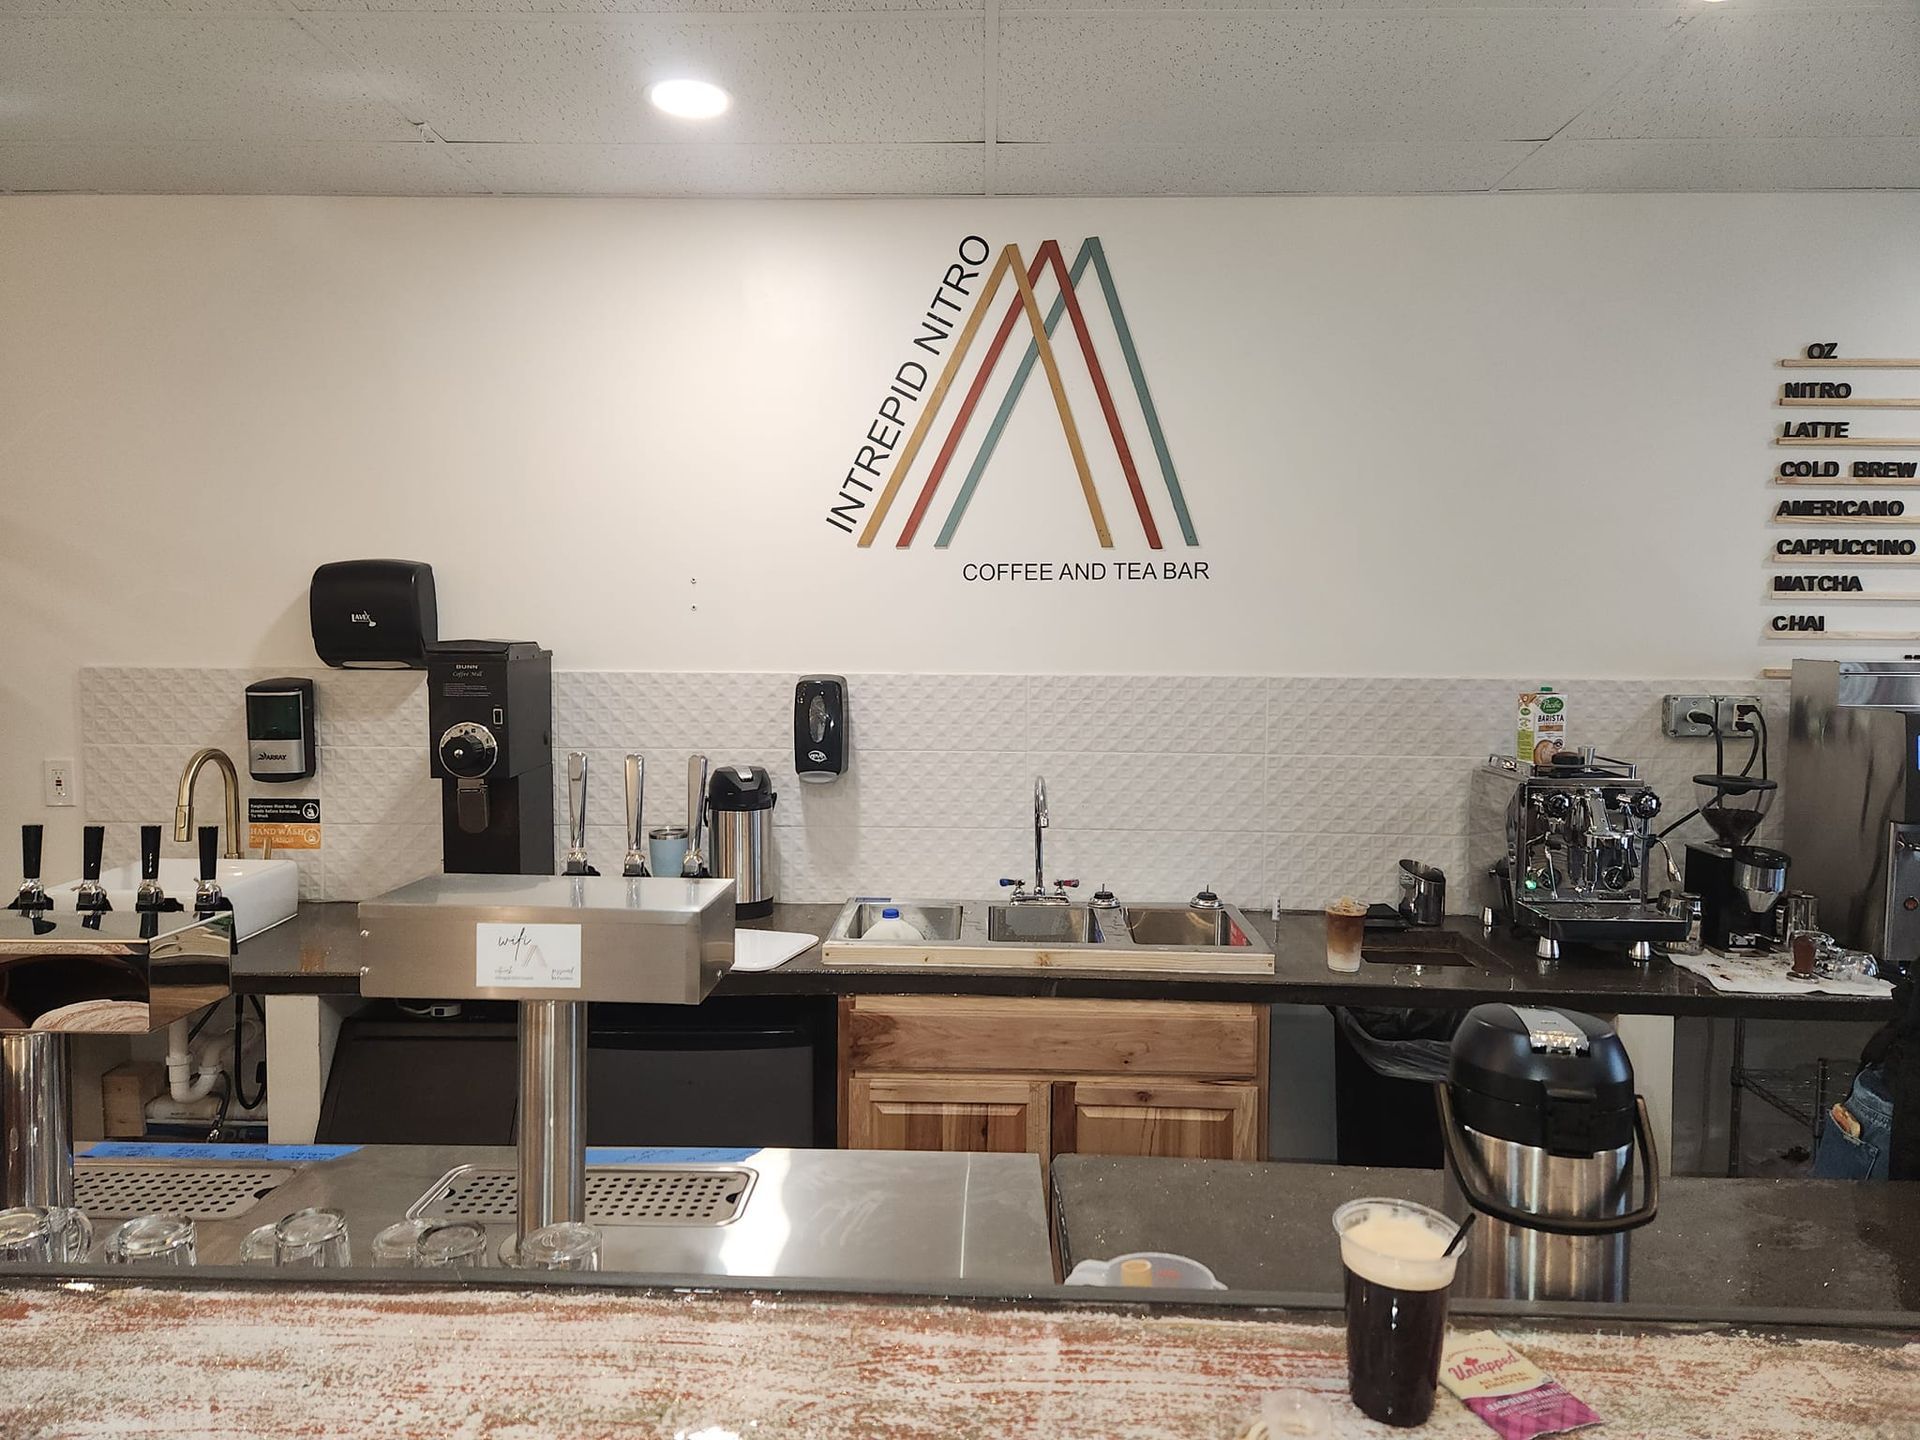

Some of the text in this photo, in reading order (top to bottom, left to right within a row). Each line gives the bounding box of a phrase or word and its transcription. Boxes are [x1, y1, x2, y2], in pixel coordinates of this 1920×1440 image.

[1807, 342, 1838, 359] OZ
[825, 234, 990, 534] INTREPID NITRO
[1784, 382, 1852, 399] NITRO
[1783, 421, 1849, 438] LATTE
[1780, 461, 1918, 478] COLD BREW
[1776, 500, 1905, 517] AMERICANO
[1776, 538, 1916, 556] CAPPUCCINO
[963, 562, 1210, 582] COFFEE AND TEA BAR
[1773, 575, 1863, 592] MATCHA
[1772, 615, 1825, 632] CHAI
[1538, 714, 1564, 722] BARISTA
[278, 828, 304, 836] WASH
[497, 927, 532, 961] wifi
